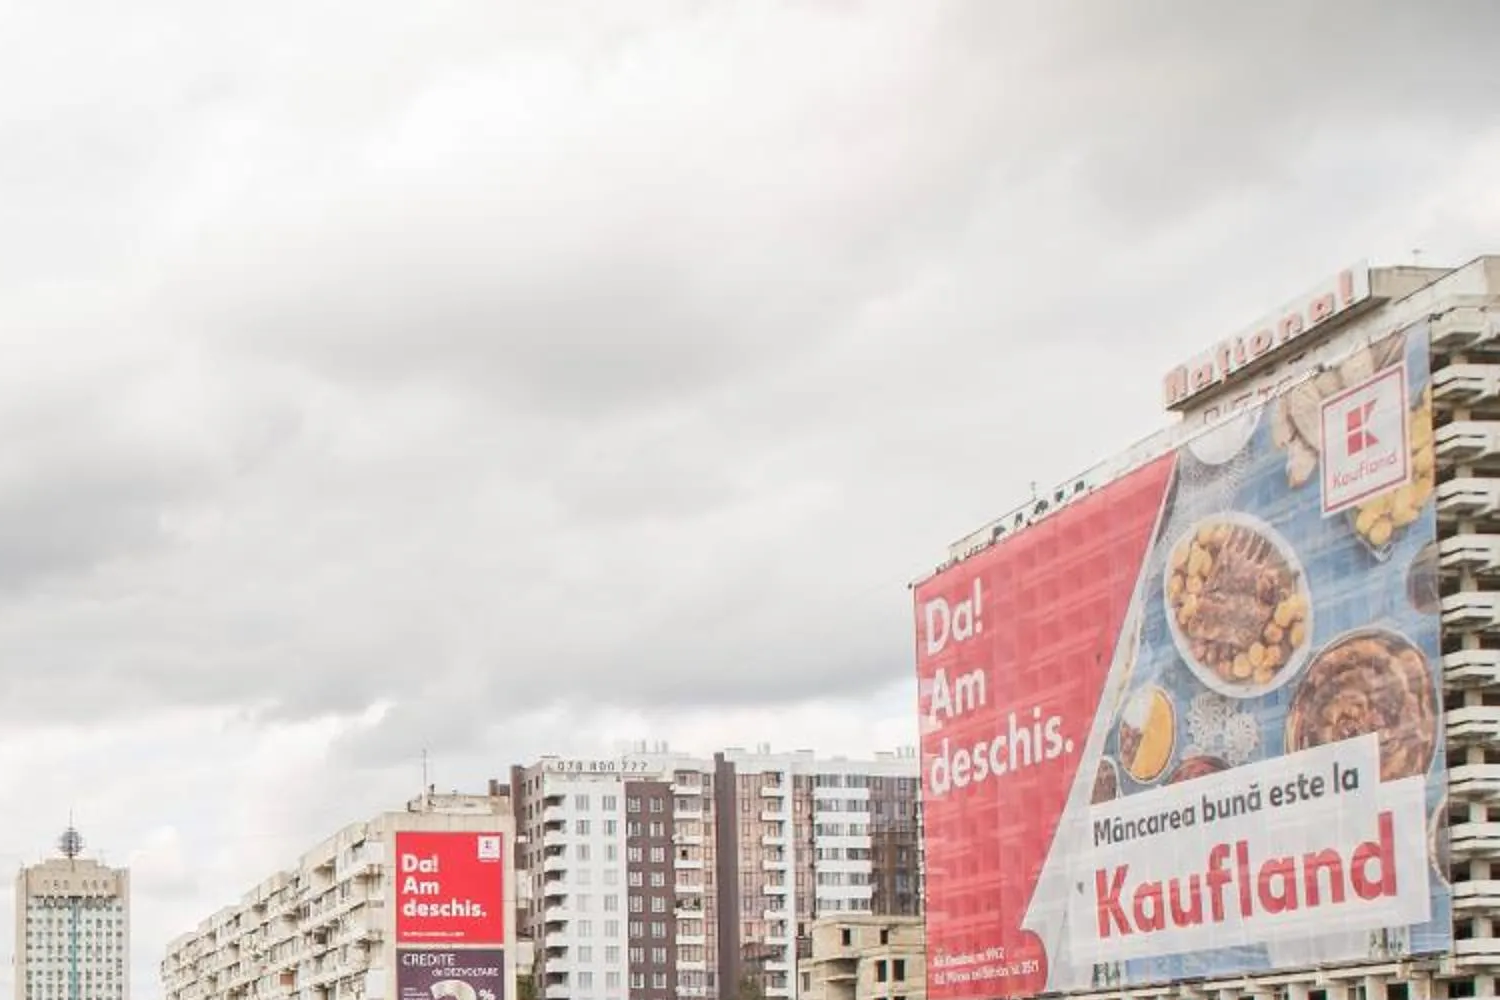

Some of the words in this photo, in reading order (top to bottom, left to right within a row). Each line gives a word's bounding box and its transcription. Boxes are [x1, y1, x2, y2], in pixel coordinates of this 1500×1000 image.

[1332, 447, 1397, 488] Kaufland
[925, 577, 983, 656] Da!
[931, 668, 986, 717] Am
[930, 706, 1075, 795] deschis.
[1093, 804, 1196, 847] Mâncarea
[1201, 784, 1262, 824] bună
[1269, 771, 1325, 807] este
[1332, 763, 1360, 794] la
[402, 853, 439, 873] Da!
[402, 875, 440, 895] Am
[1095, 811, 1398, 938] Kaufland
[403, 898, 488, 918] deschis.
[403, 953, 457, 967] CREDITE
